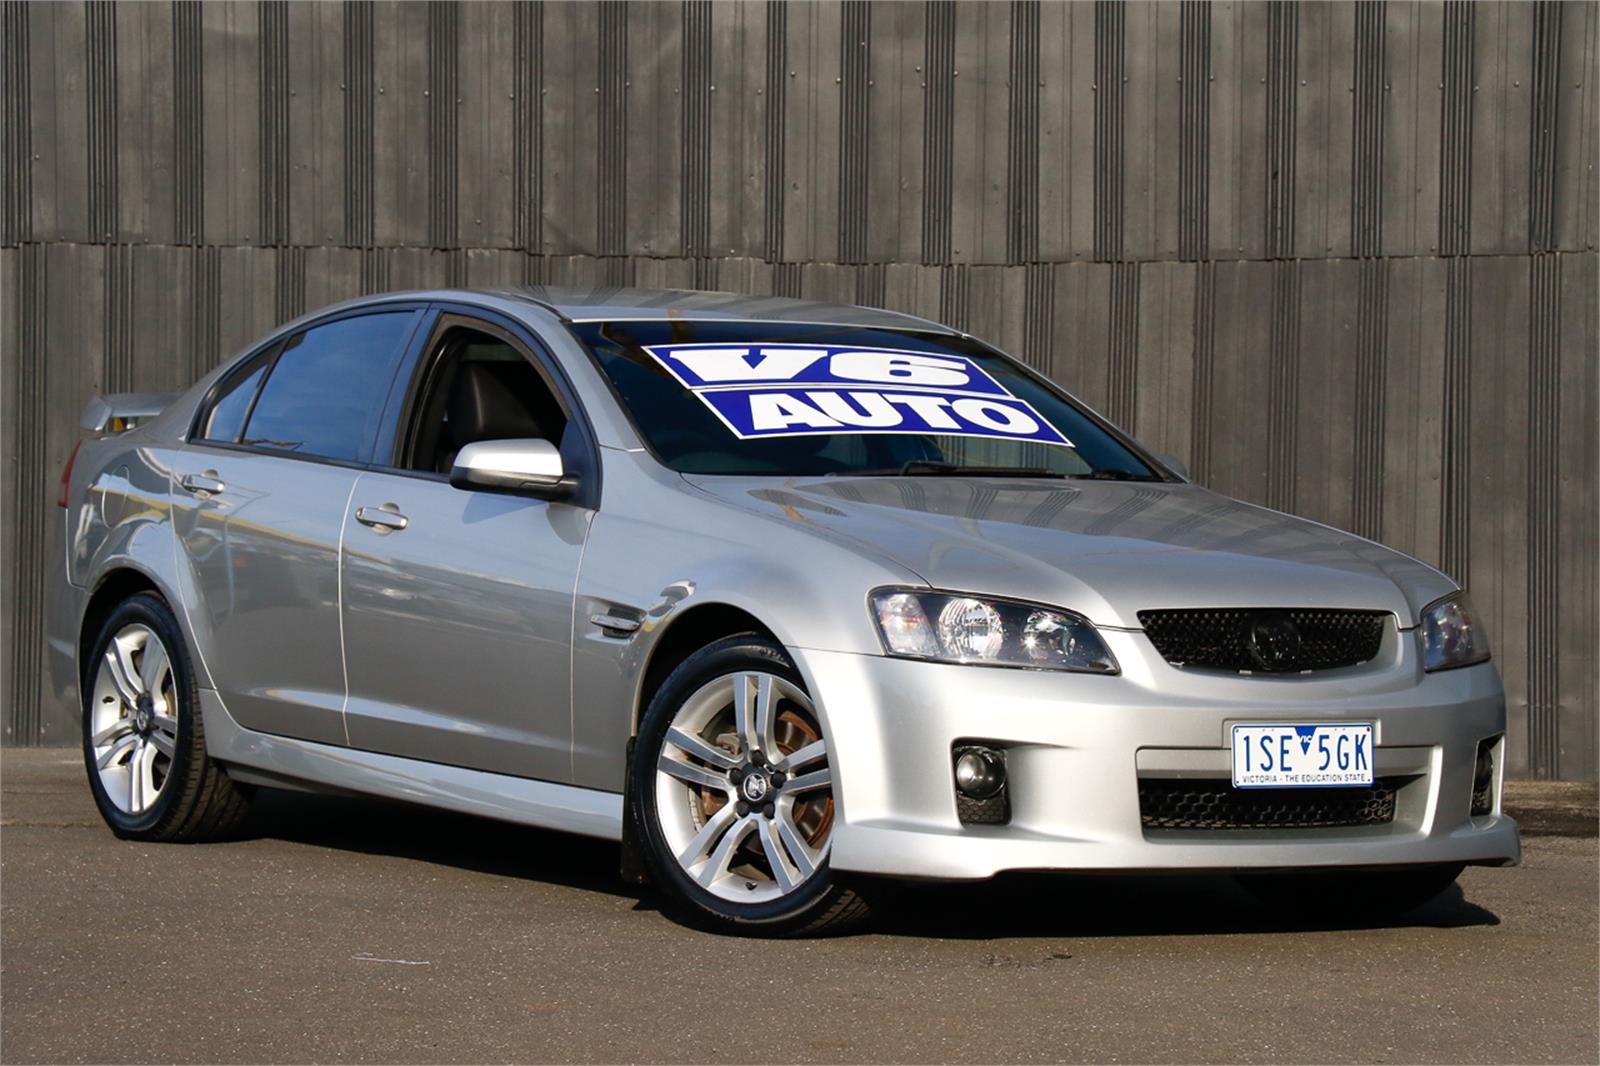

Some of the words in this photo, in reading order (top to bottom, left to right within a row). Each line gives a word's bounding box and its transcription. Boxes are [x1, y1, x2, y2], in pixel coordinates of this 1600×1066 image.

[669, 348, 971, 386] V6
[748, 391, 1040, 434] AUTO
[1242, 775, 1277, 783] VICTORIA
[1285, 775, 1299, 783] THE
[1301, 774, 1342, 782] EDUCATION
[1344, 773, 1365, 782] STATE
